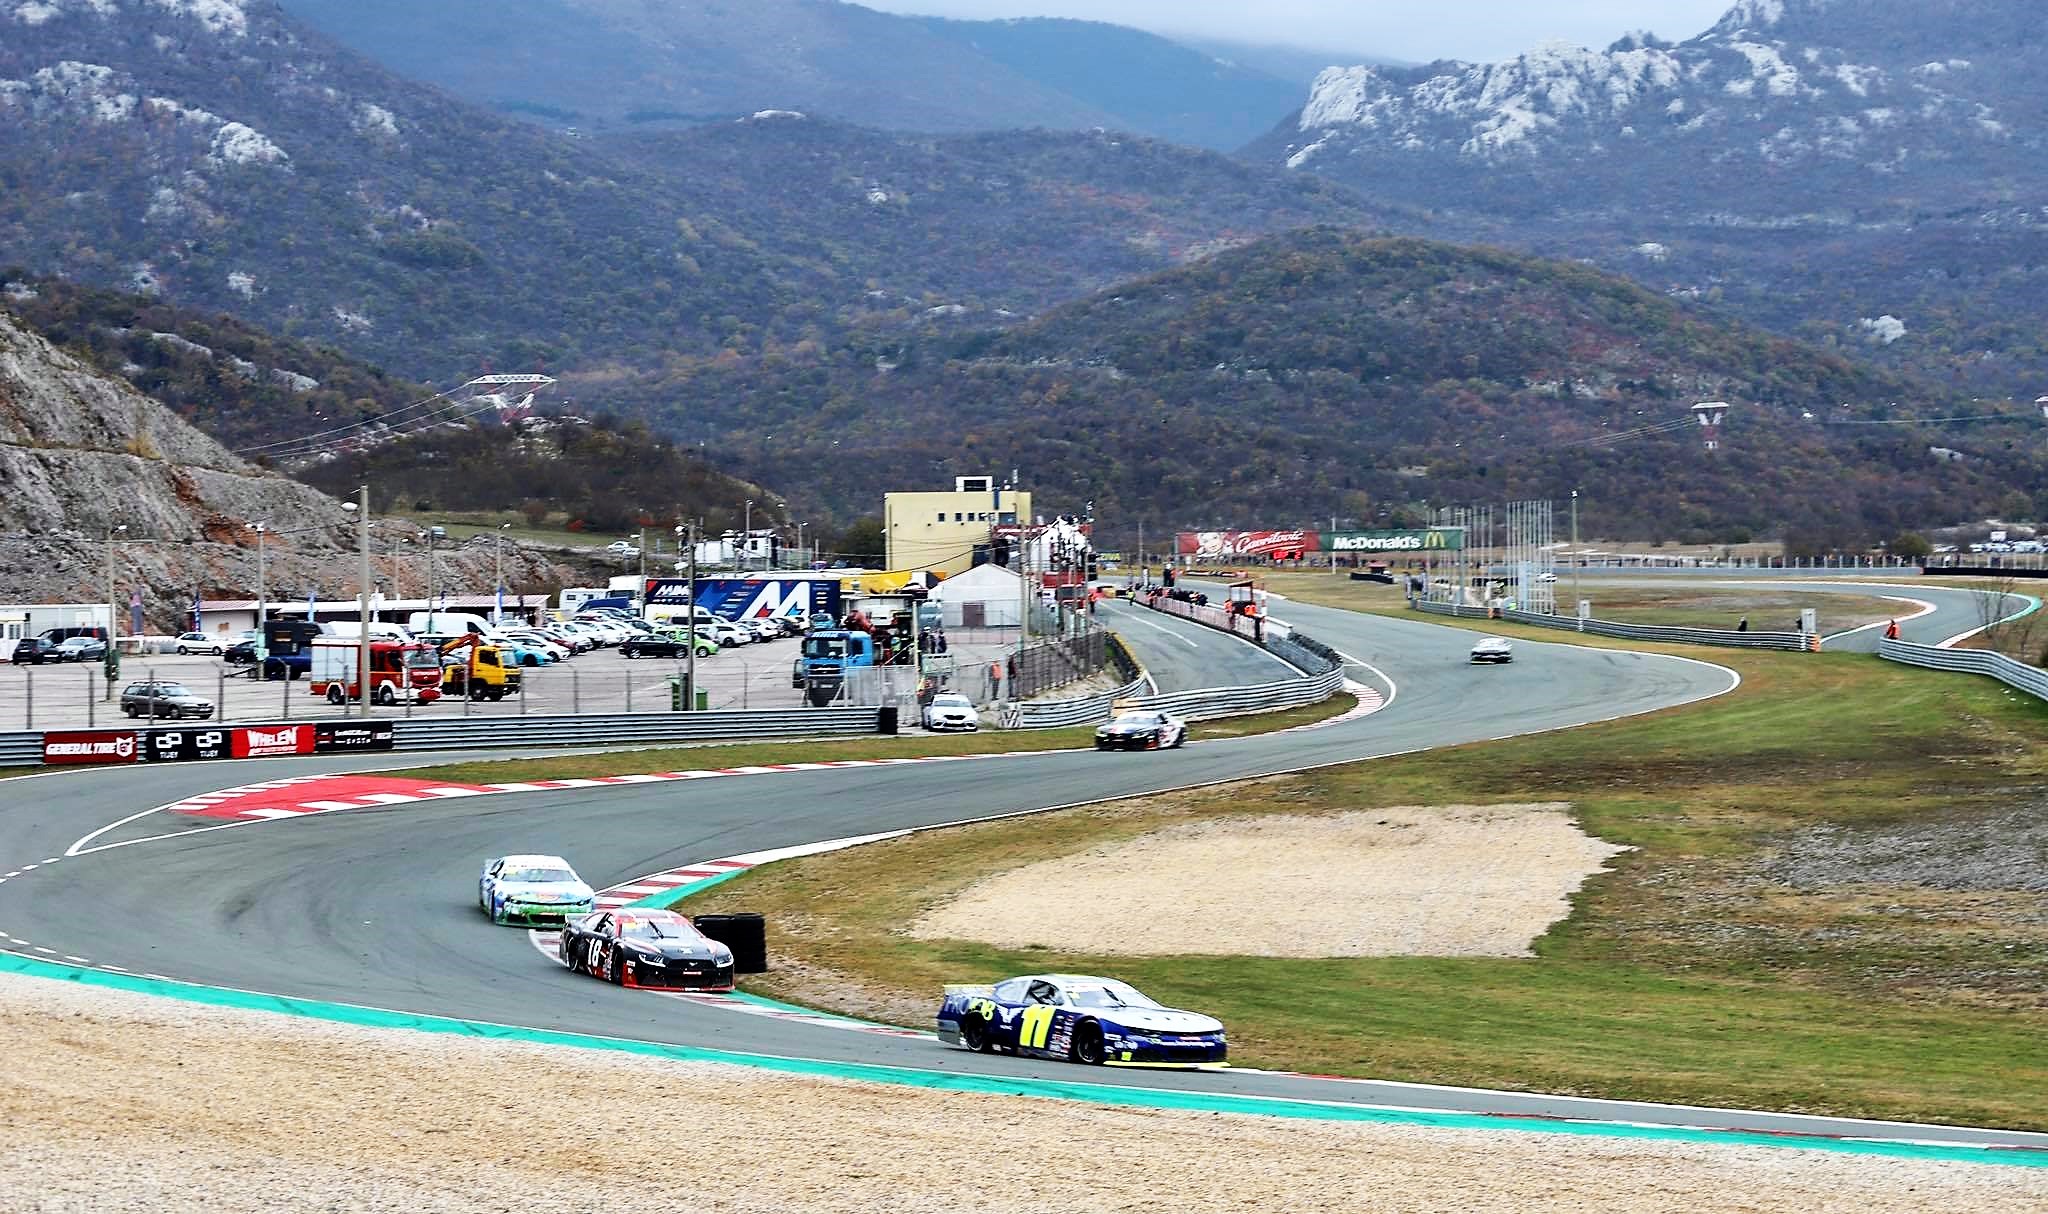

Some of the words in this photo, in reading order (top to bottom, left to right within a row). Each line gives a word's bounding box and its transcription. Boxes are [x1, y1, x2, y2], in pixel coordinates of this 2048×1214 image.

[1332, 536, 1421, 550] McDonald's
[247, 727, 298, 748] WHELEN
[46, 743, 93, 755] GENERAL
[92, 742, 117, 754] TIRE
[588, 938, 603, 967] 18
[1019, 1003, 1057, 1049] 11
